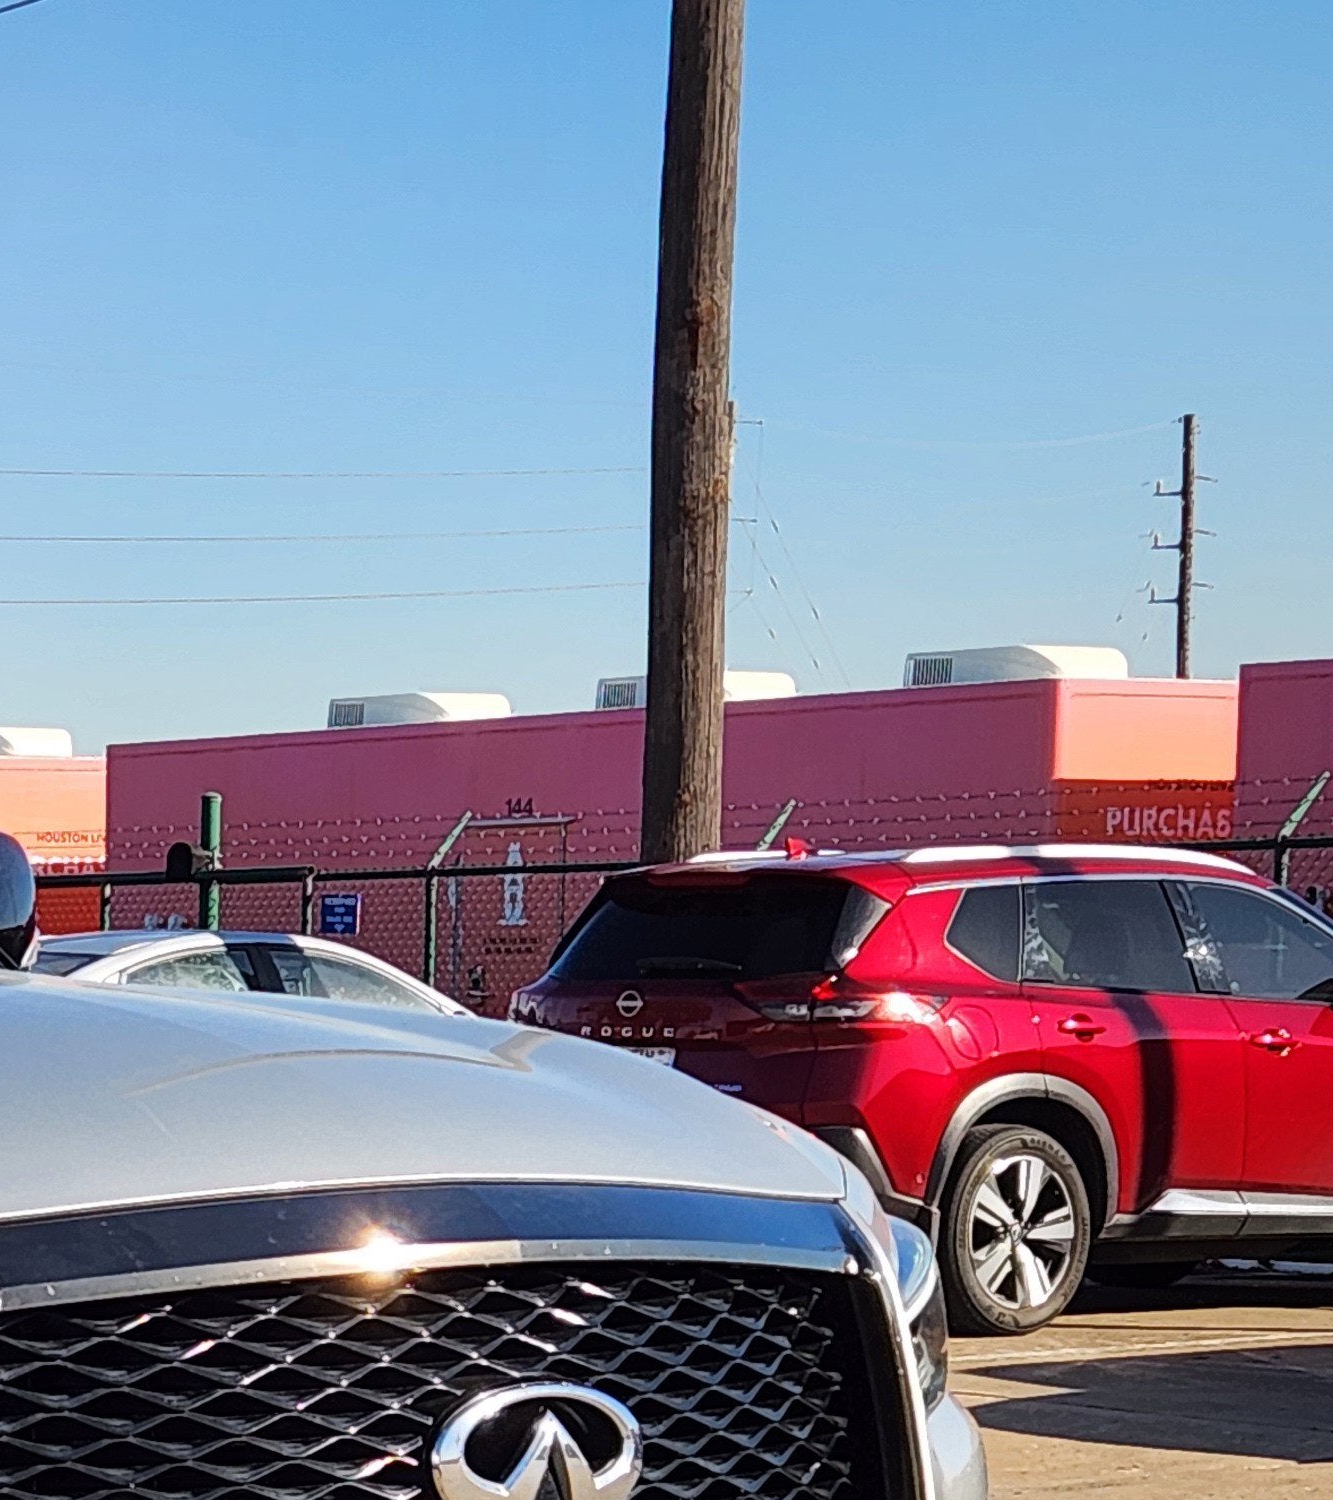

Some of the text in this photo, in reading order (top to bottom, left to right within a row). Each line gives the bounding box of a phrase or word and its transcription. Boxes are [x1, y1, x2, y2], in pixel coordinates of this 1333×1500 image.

[505, 797, 533, 816] 144
[36, 831, 88, 842] HOUSTON
[581, 1026, 674, 1037] ROGUE
